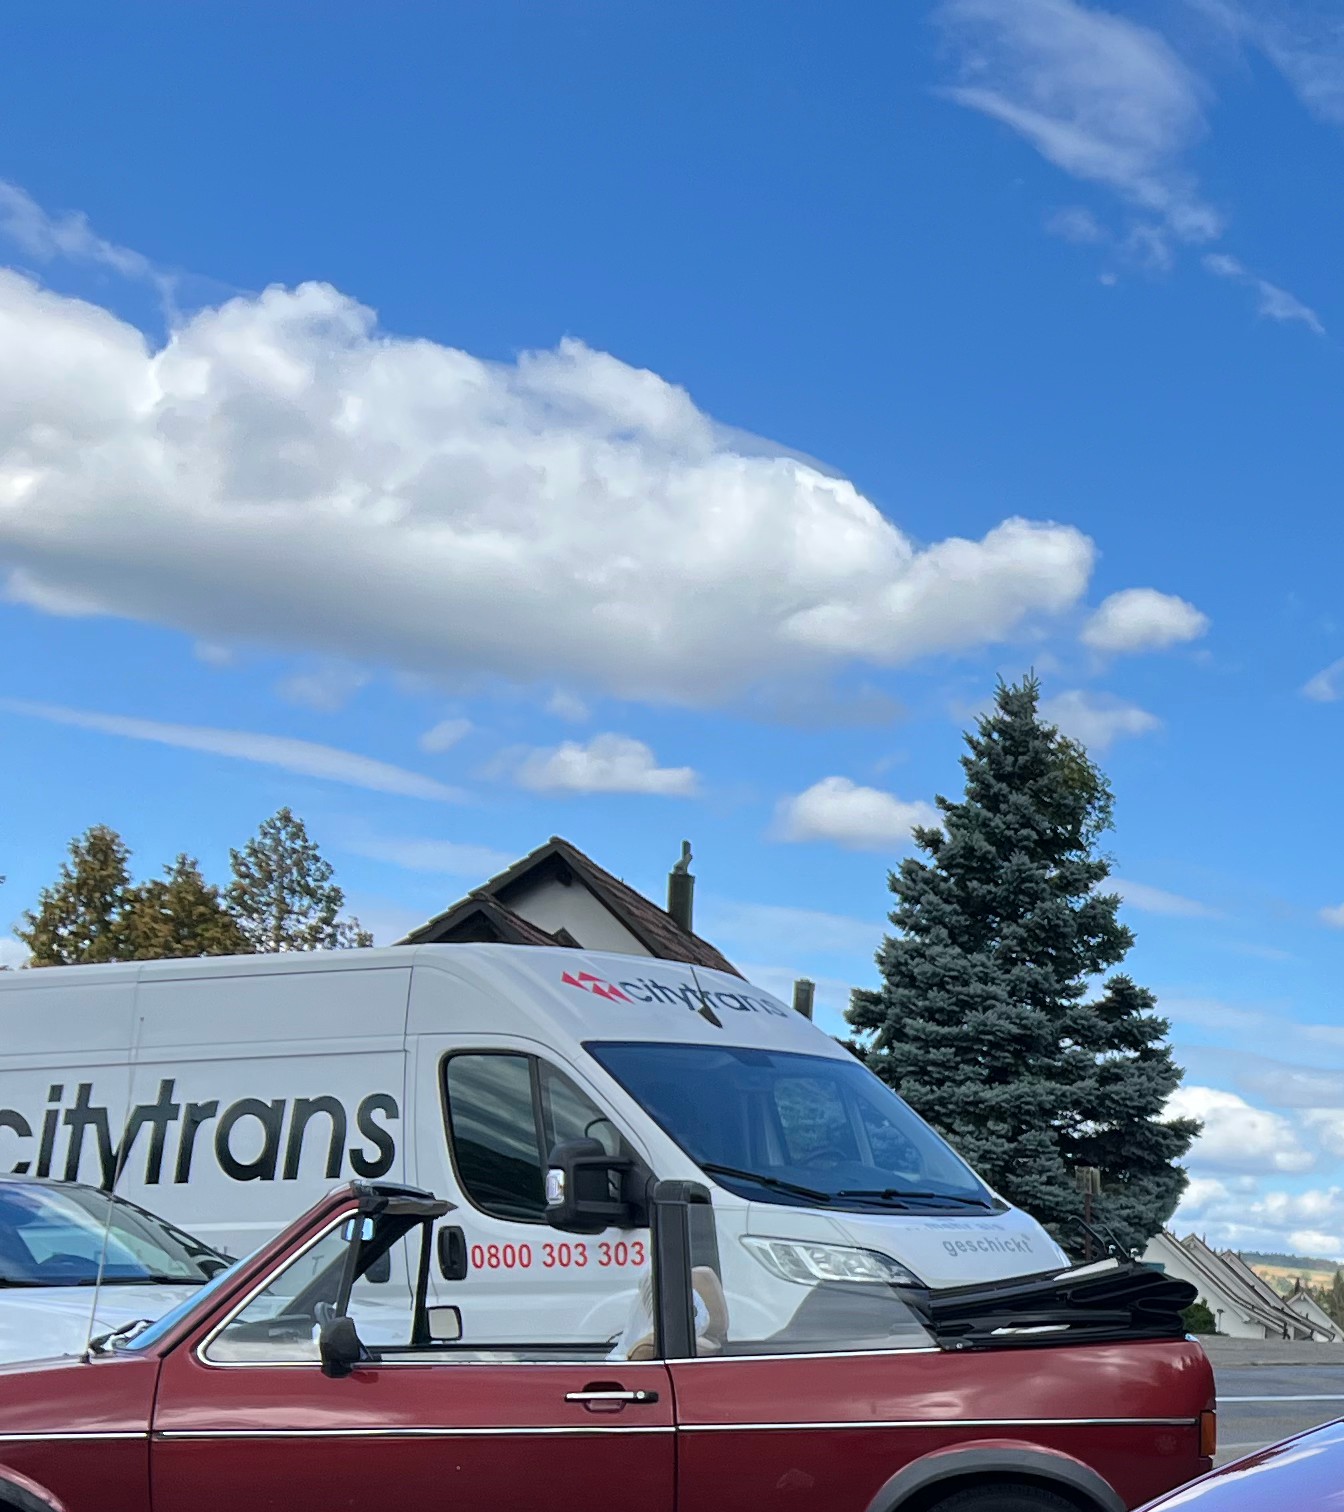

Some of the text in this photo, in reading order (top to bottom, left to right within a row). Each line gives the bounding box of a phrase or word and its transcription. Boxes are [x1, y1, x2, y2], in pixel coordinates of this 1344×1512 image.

[618, 977, 789, 1018] citytrans
[471, 1241, 646, 1270] 0800 303 303
